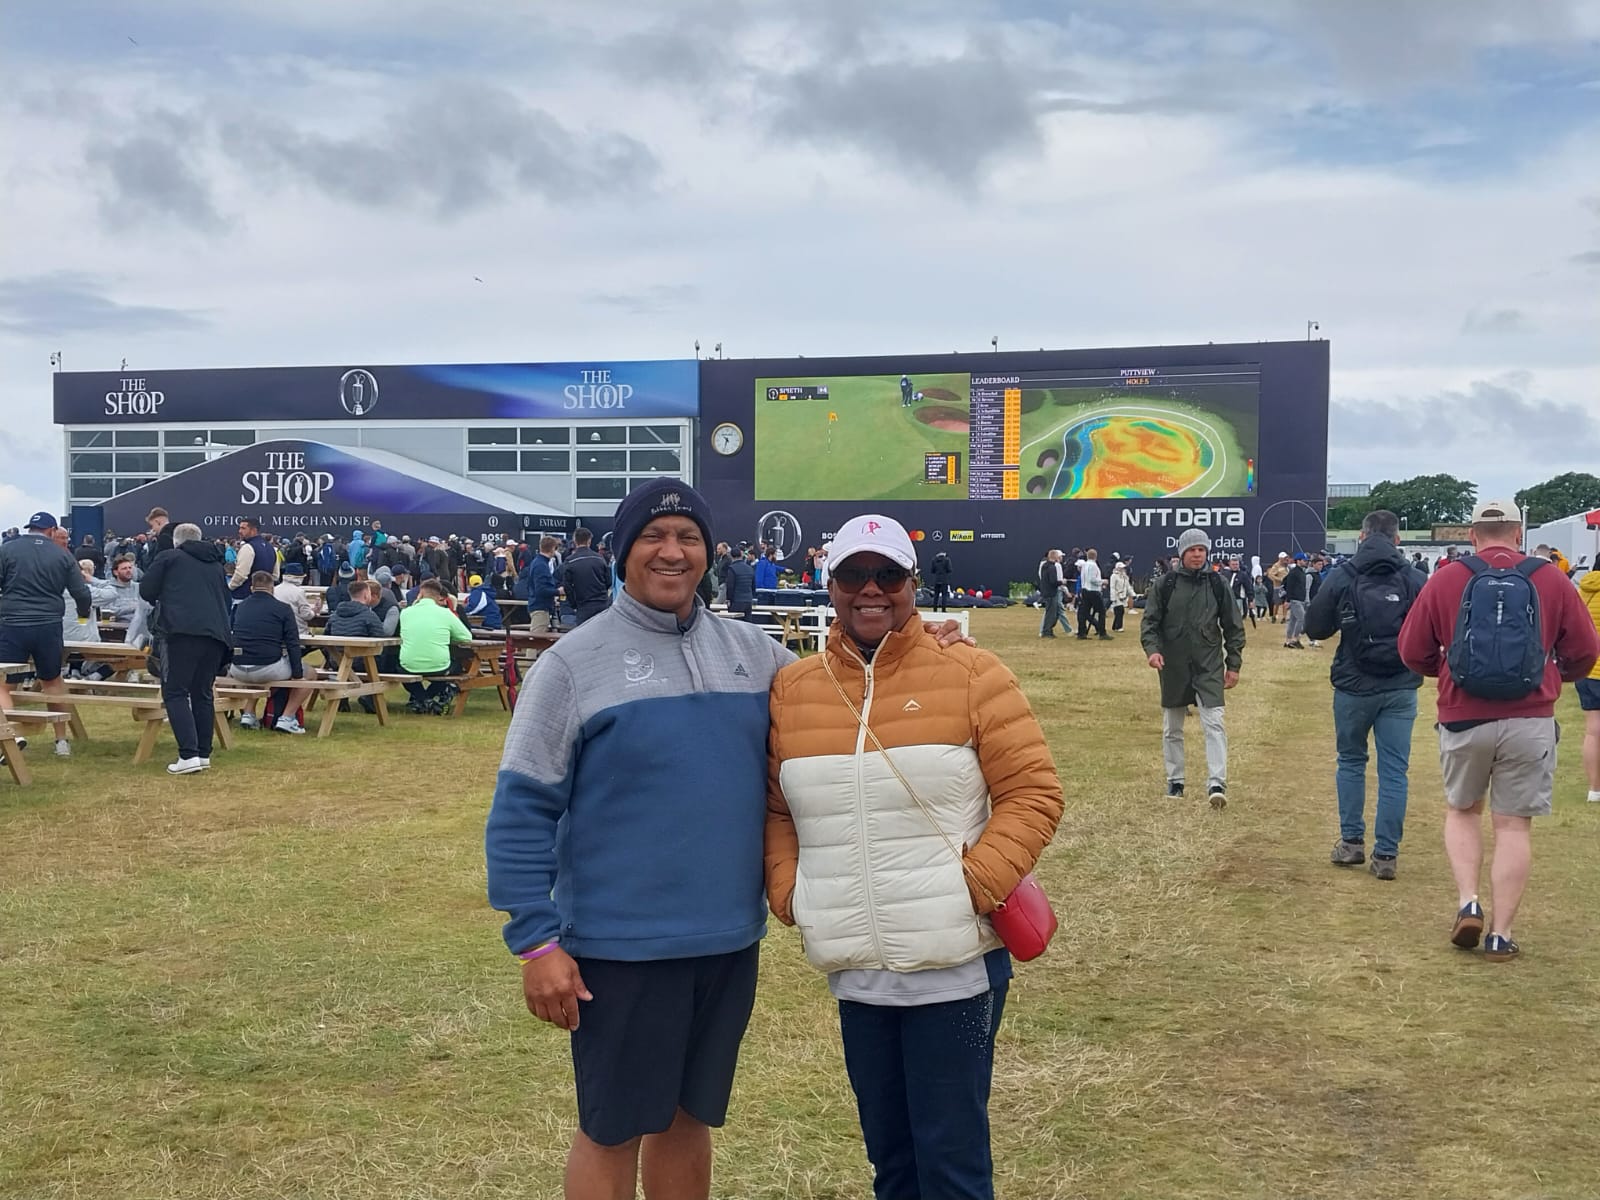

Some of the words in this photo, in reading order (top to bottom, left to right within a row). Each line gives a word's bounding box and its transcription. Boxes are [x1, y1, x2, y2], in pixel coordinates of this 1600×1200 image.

[580, 370, 612, 384] THE
[971, 376, 1020, 385] LEADERBOARD
[120, 378, 146, 391] THE
[104, 391, 165, 415] SHOP
[563, 384, 633, 409] SHOP
[265, 452, 305, 470] THE
[241, 471, 334, 505] SHOP
[204, 515, 266, 526] OFFICL
[272, 515, 370, 527] MERCHANDISE
[539, 519, 567, 528] ENTRANCE
[1121, 508, 1173, 527] NTT
[1215, 536, 1245, 548] data
